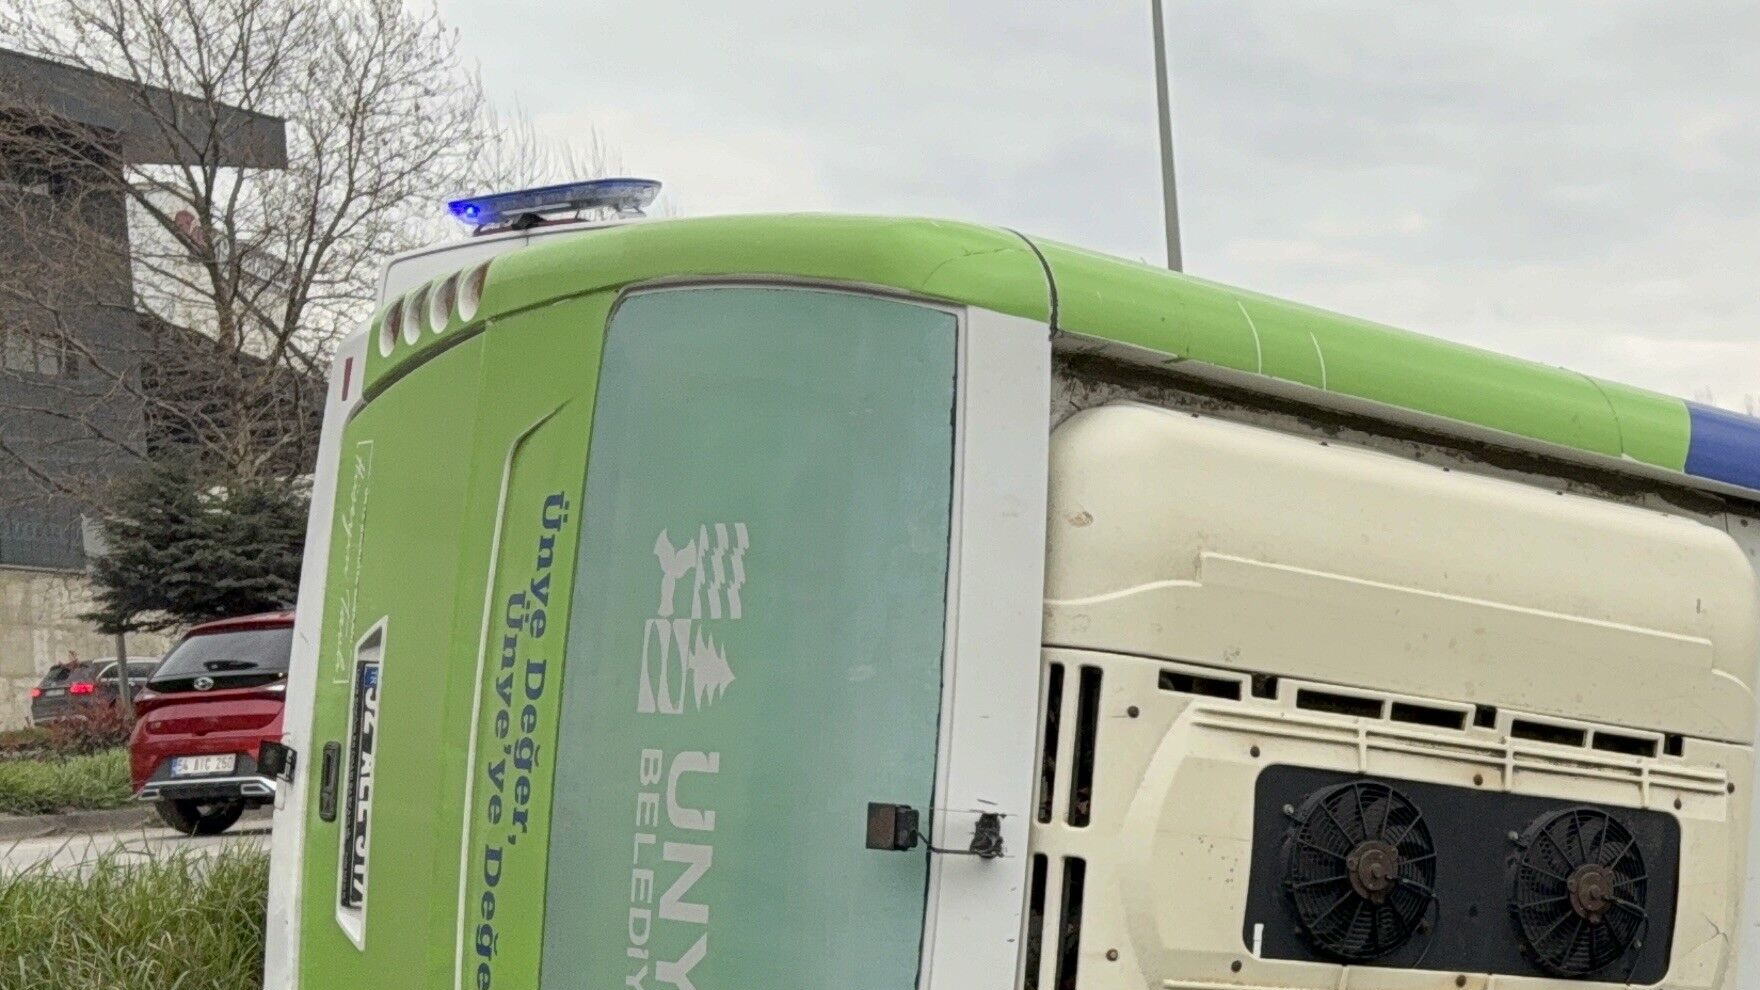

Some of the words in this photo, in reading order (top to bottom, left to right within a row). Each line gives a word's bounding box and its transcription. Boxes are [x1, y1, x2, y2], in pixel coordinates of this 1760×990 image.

[526, 491, 570, 638] Ünye
[487, 591, 530, 825] Ünye'ye
[506, 659, 547, 846] Değer,
